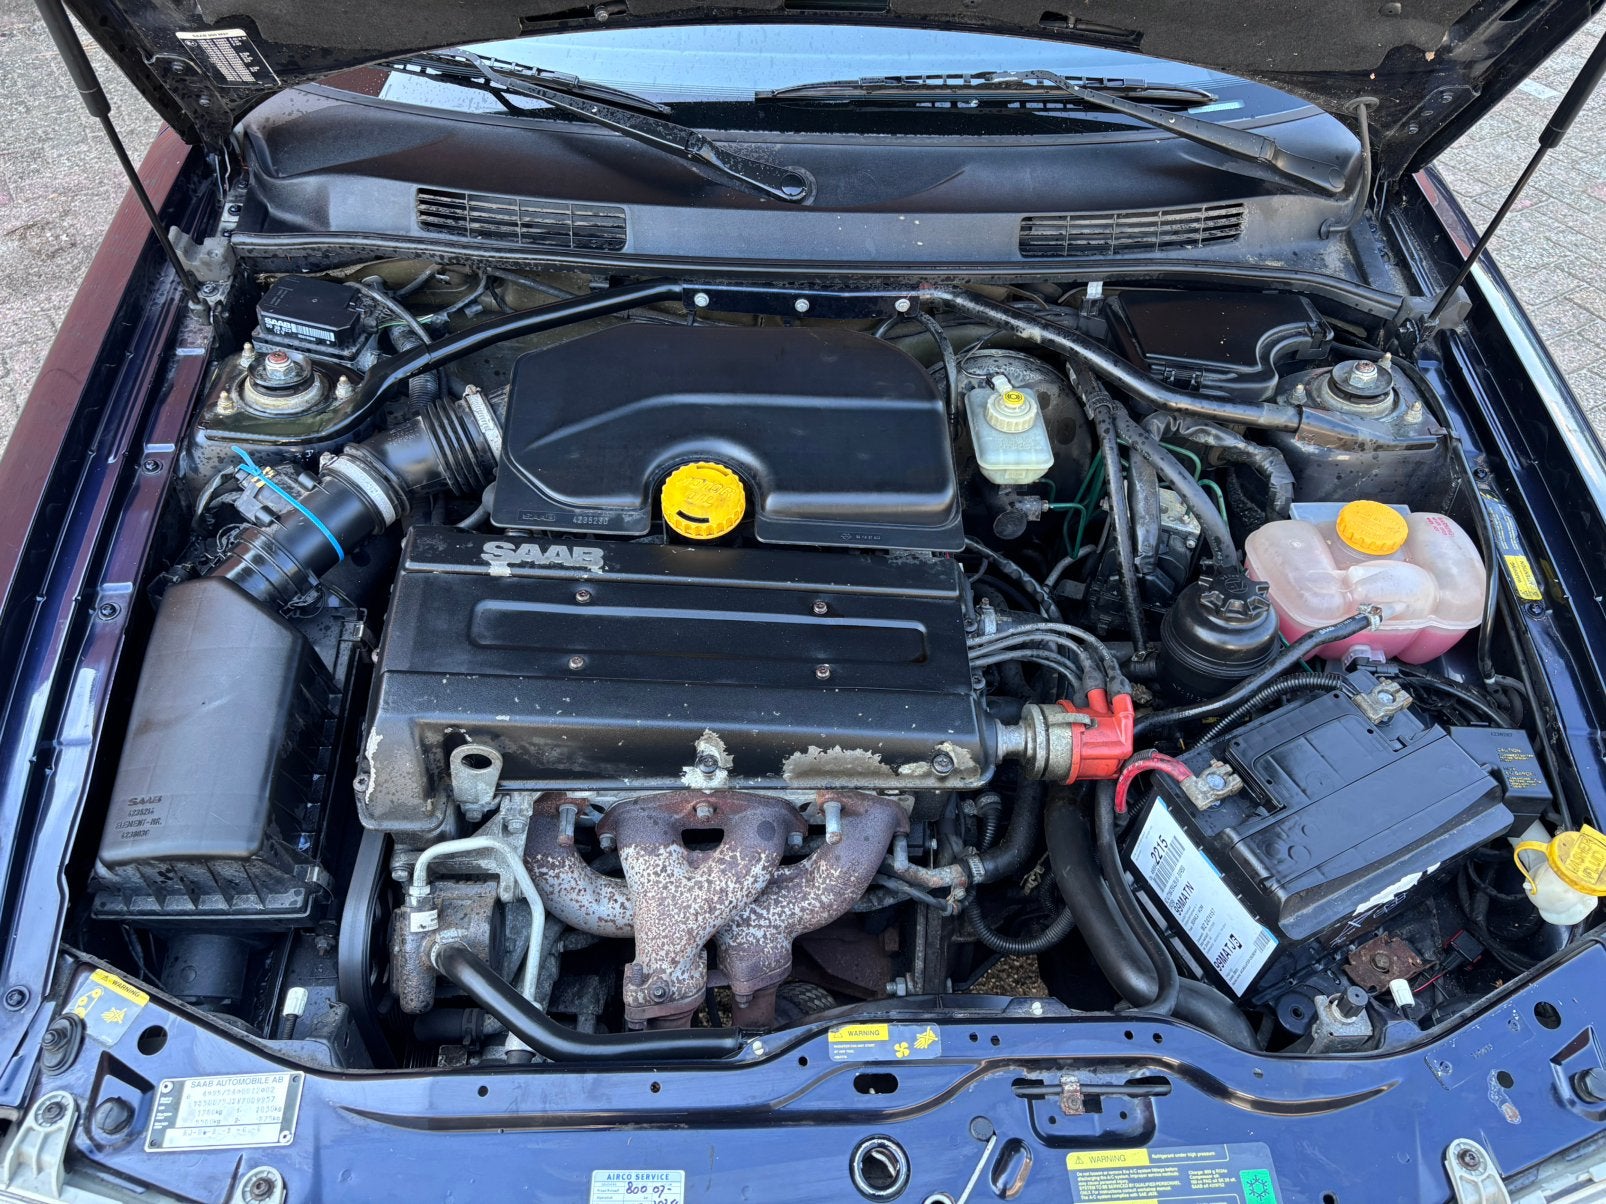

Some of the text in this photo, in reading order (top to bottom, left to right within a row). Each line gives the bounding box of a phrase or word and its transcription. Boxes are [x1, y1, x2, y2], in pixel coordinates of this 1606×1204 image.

[481, 541, 604, 570] SAAB
[128, 795, 162, 806] SAAB
[1150, 834, 1168, 865] 2215
[112, 980, 140, 998] WARNING
[216, 1077, 271, 1086] AUTOMOBILE
[1089, 1155, 1126, 1164] WARNING
[626, 1181, 648, 1194] 800
